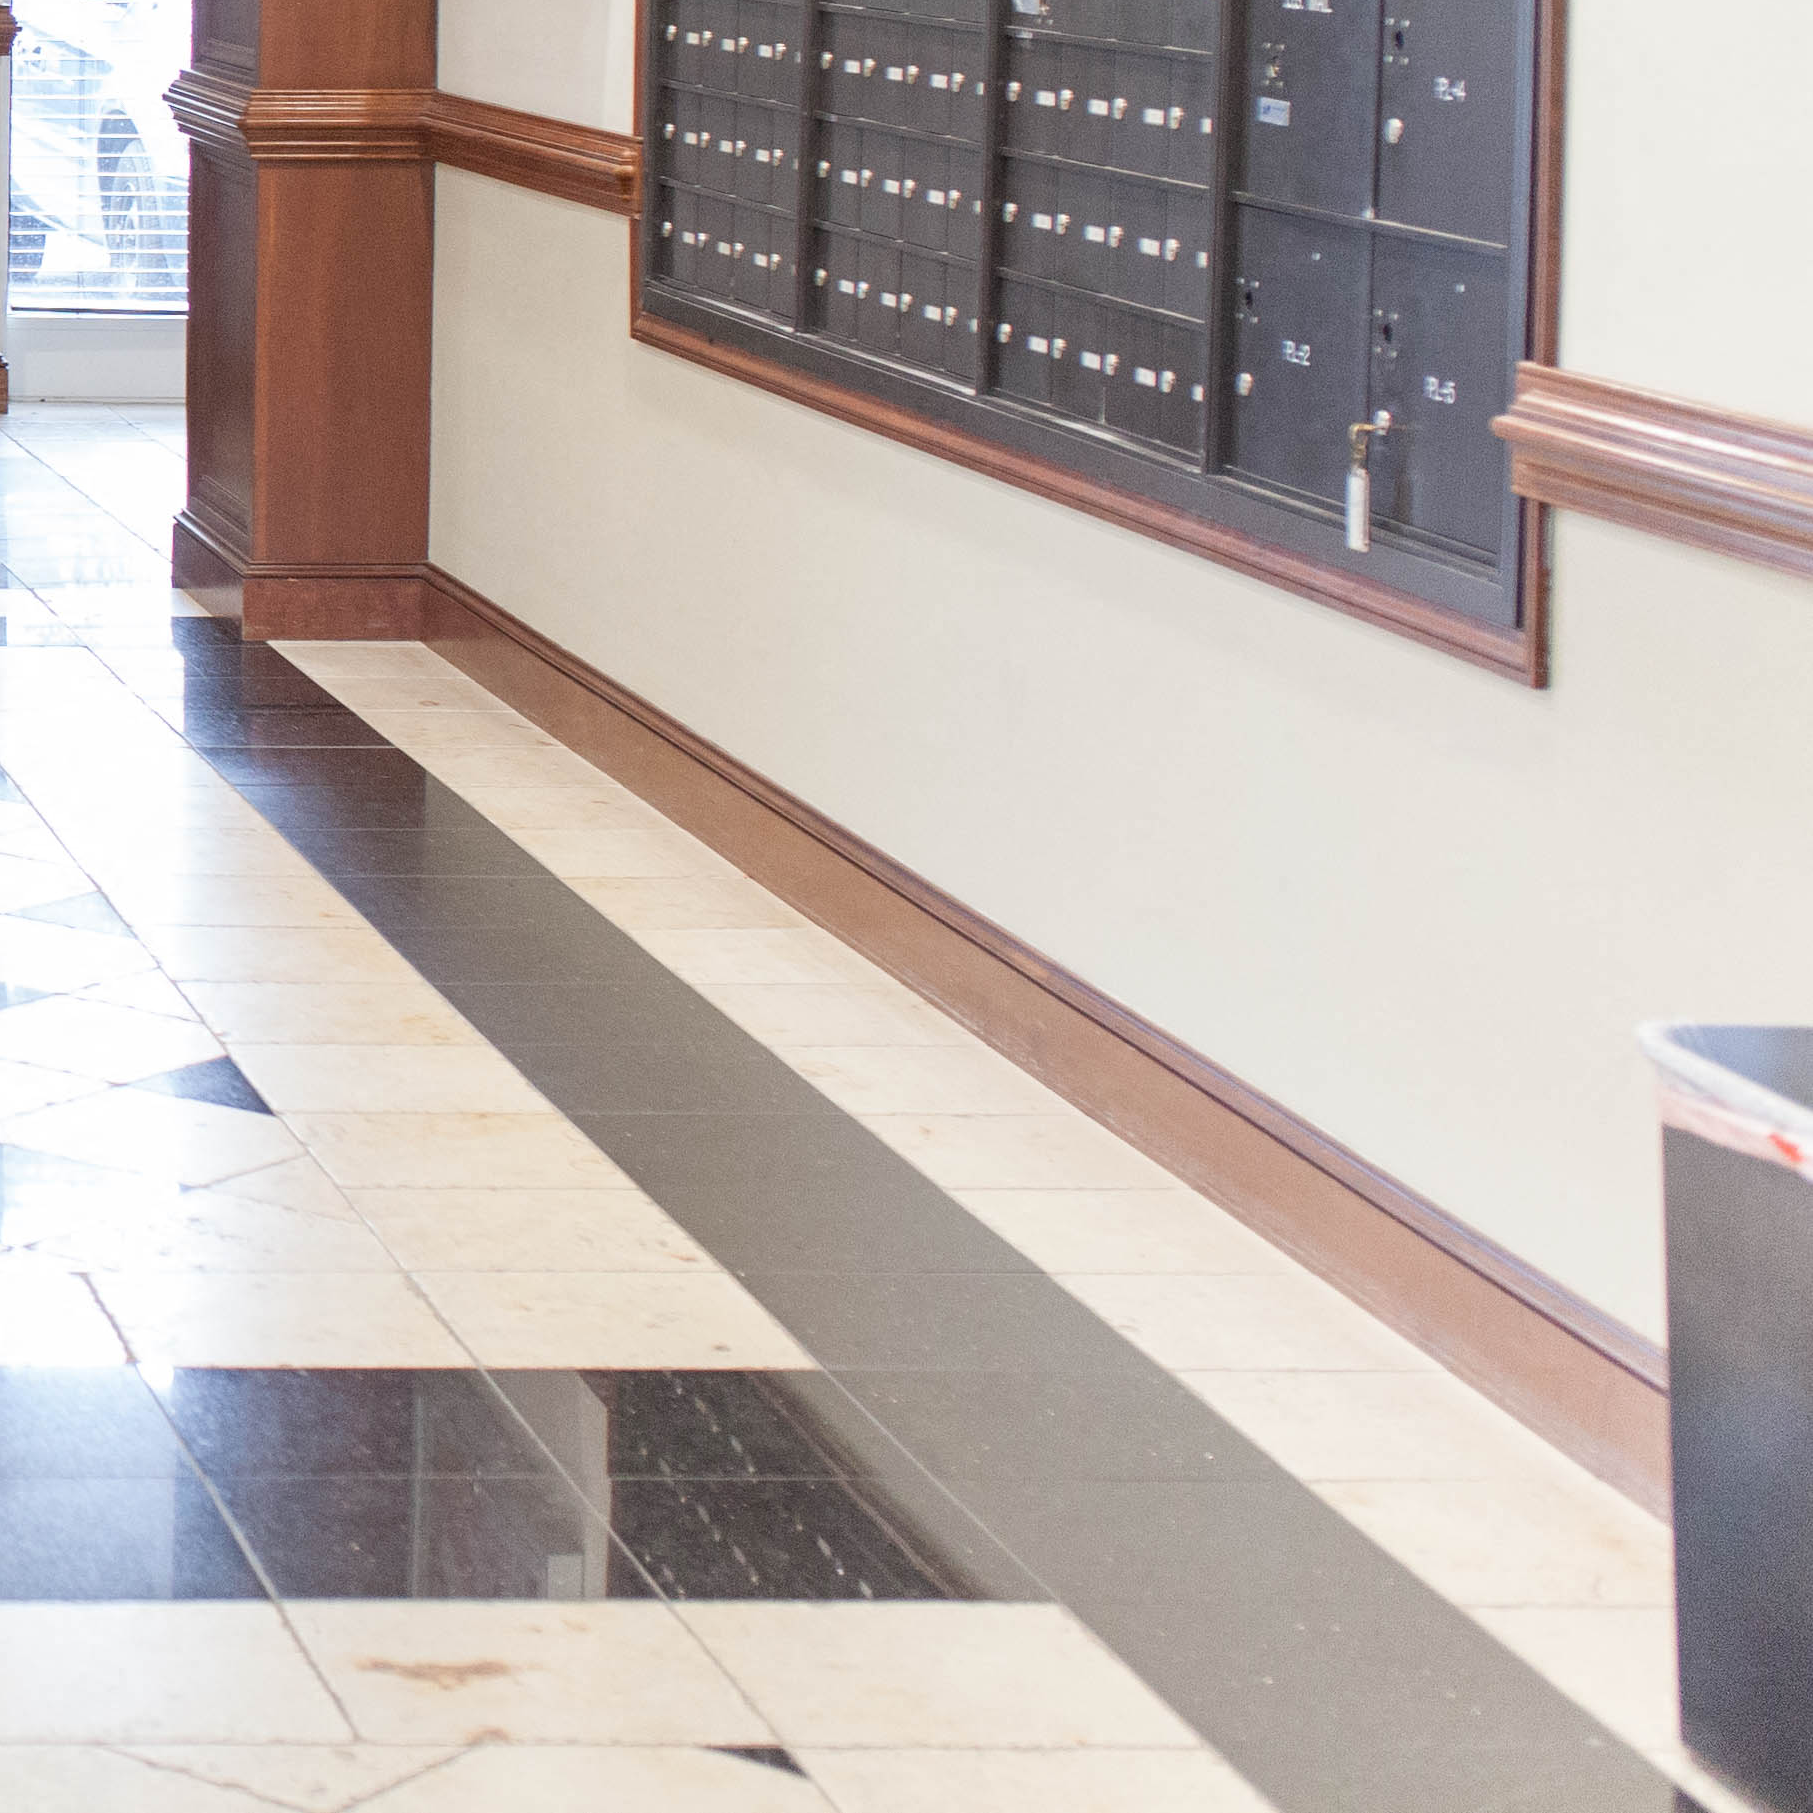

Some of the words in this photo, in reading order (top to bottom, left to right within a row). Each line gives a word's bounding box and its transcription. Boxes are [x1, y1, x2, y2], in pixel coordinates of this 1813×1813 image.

[1434, 76, 1466, 102] PL-4
[1282, 340, 1311, 366] PL-2
[1424, 376, 1457, 404] PL-5
